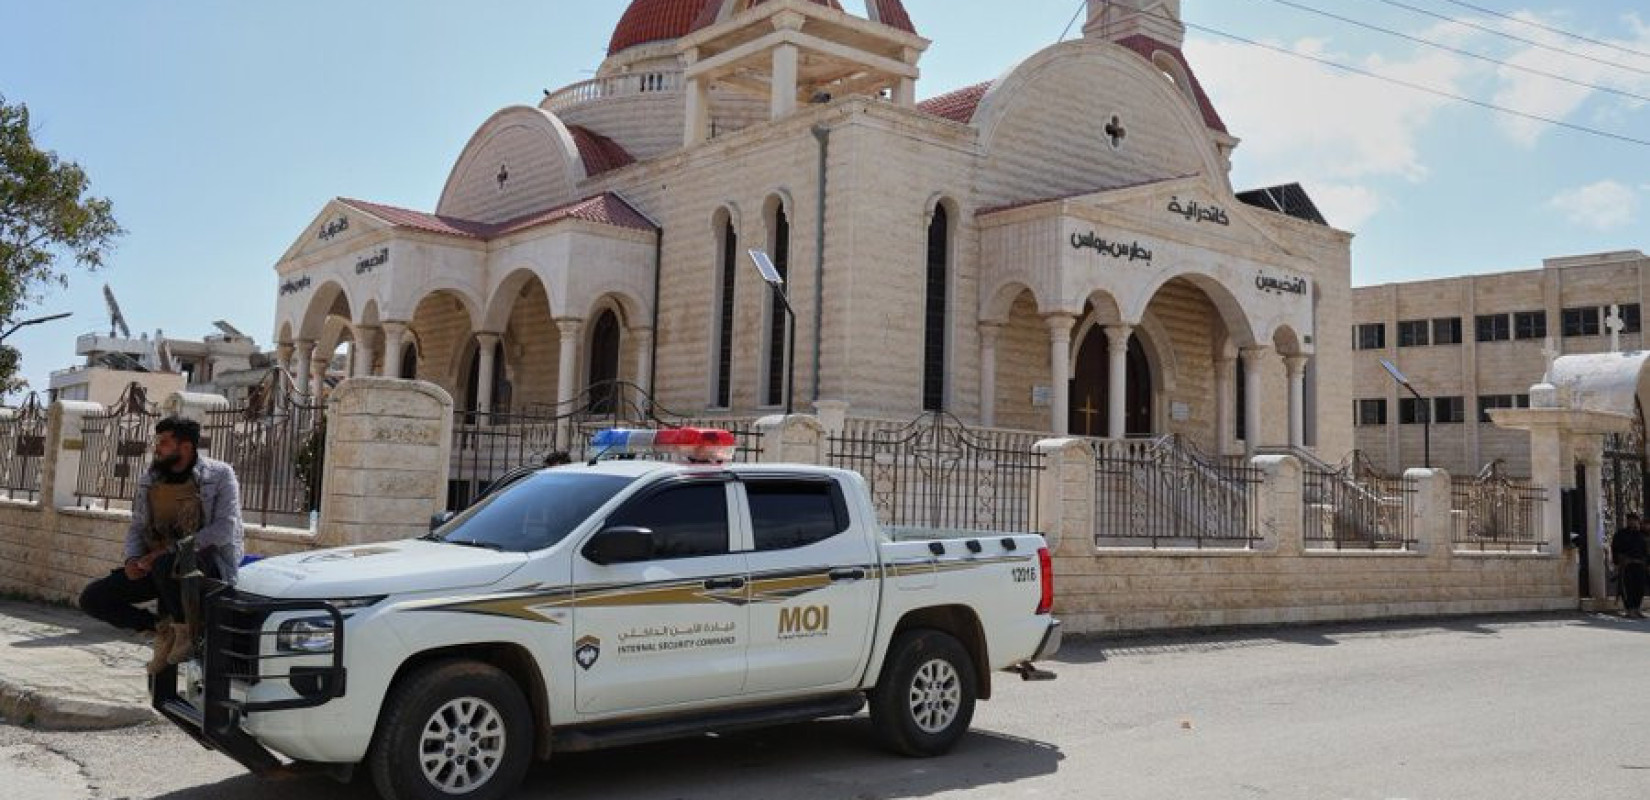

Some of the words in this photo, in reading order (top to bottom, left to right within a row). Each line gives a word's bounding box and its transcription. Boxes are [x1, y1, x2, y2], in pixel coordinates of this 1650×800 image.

[778, 604, 829, 633] MOI
[617, 643, 655, 655] INTERNAL
[658, 640, 694, 650] SECURITY
[695, 636, 735, 648] COMMAND
